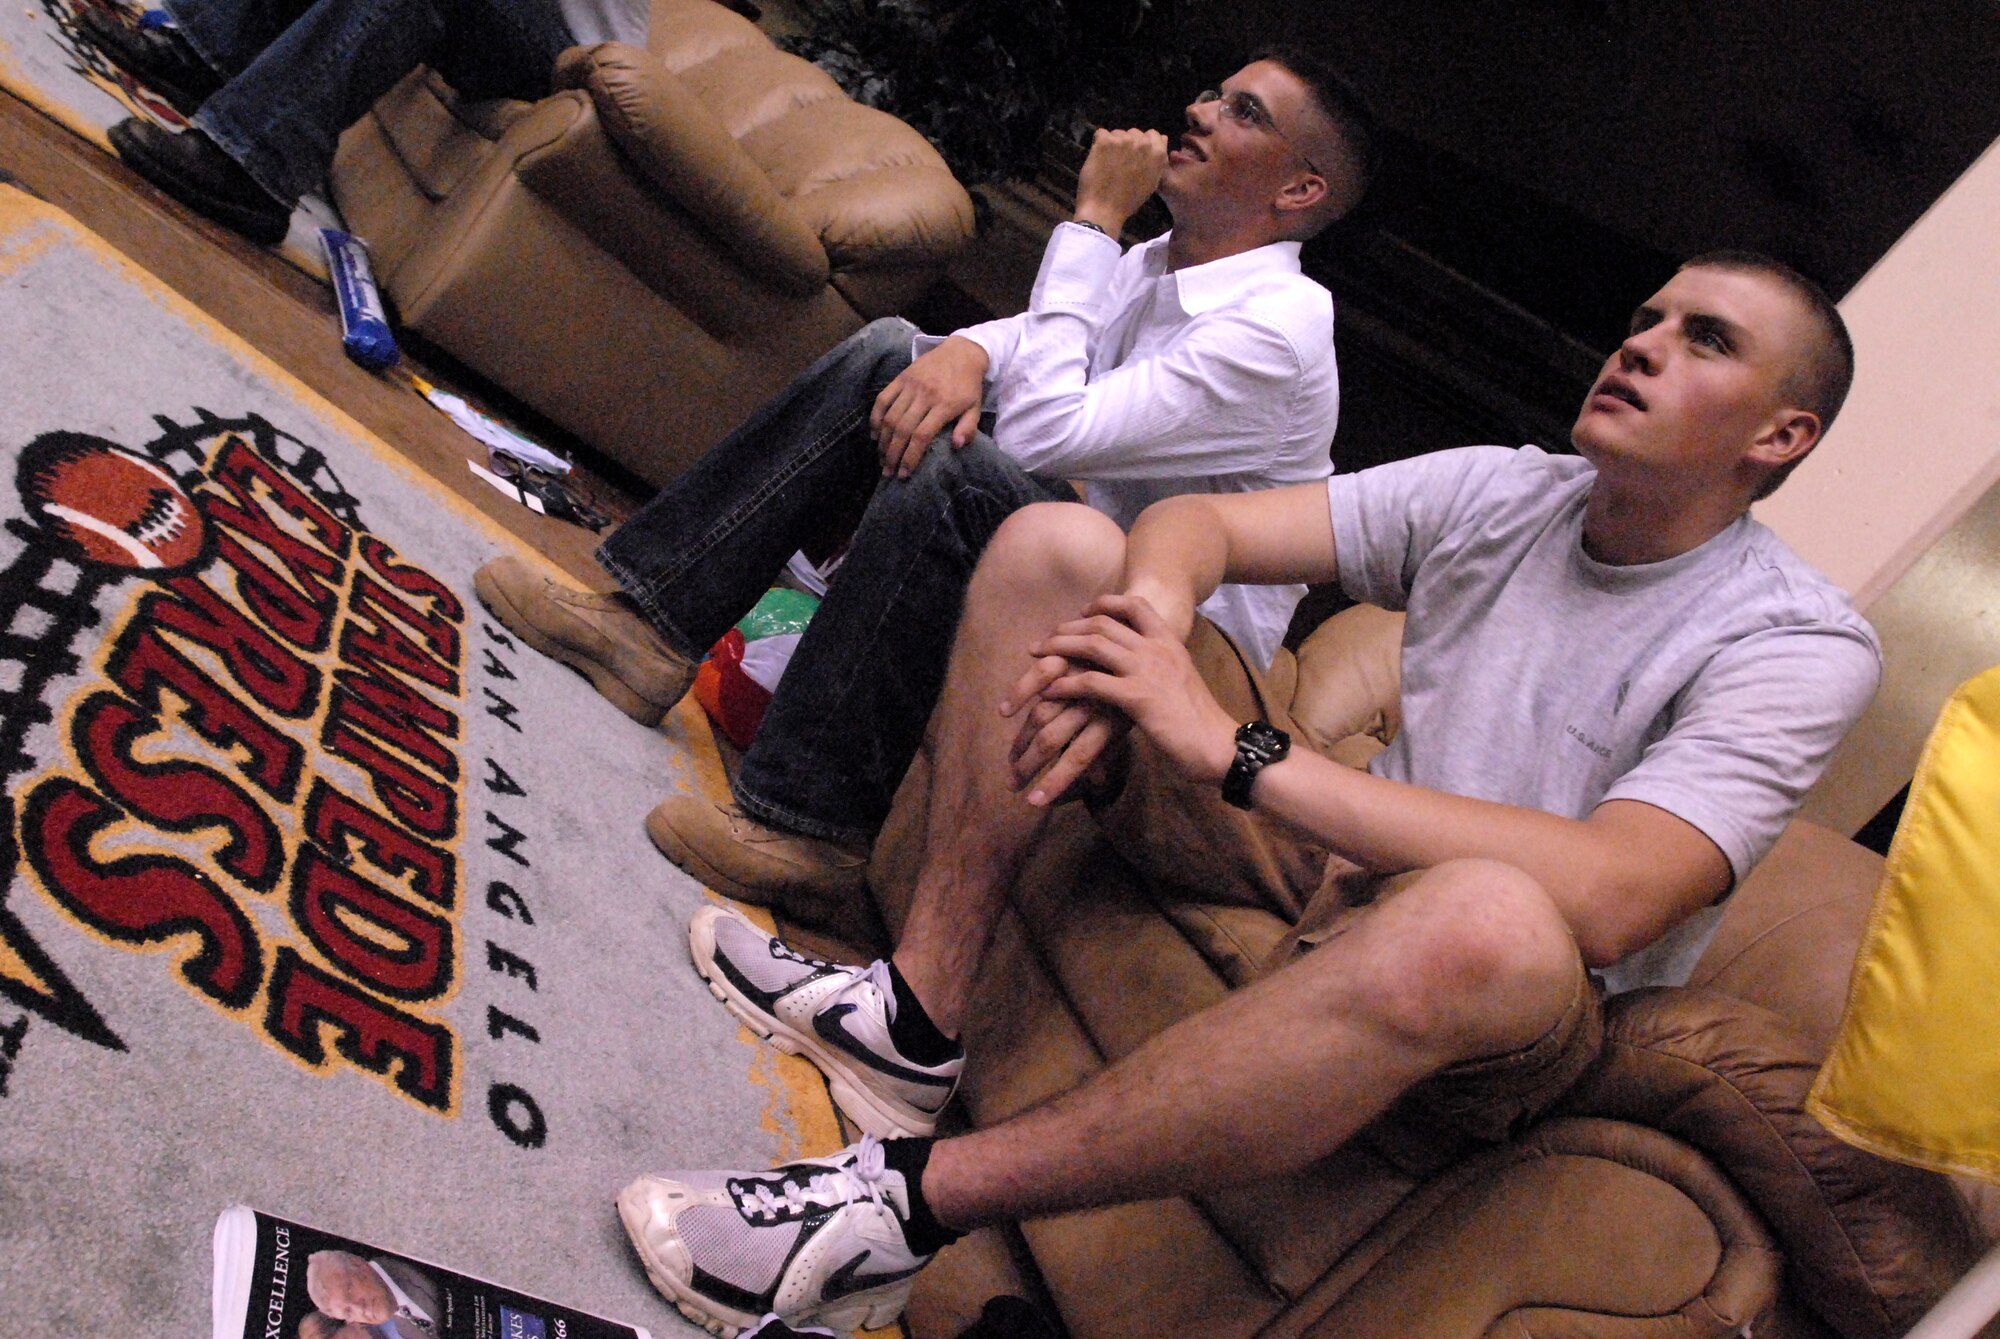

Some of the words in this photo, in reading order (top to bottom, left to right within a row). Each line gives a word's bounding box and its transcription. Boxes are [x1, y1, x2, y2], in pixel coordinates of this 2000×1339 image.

[19, 433, 352, 1010] EXPRESS
[482, 623, 523, 733] SAN
[263, 532, 467, 1112] STAMPEDE
[484, 756, 547, 1149] ANGELO
[510, 1313, 522, 1339] KES
[554, 1318, 567, 1339] 66
